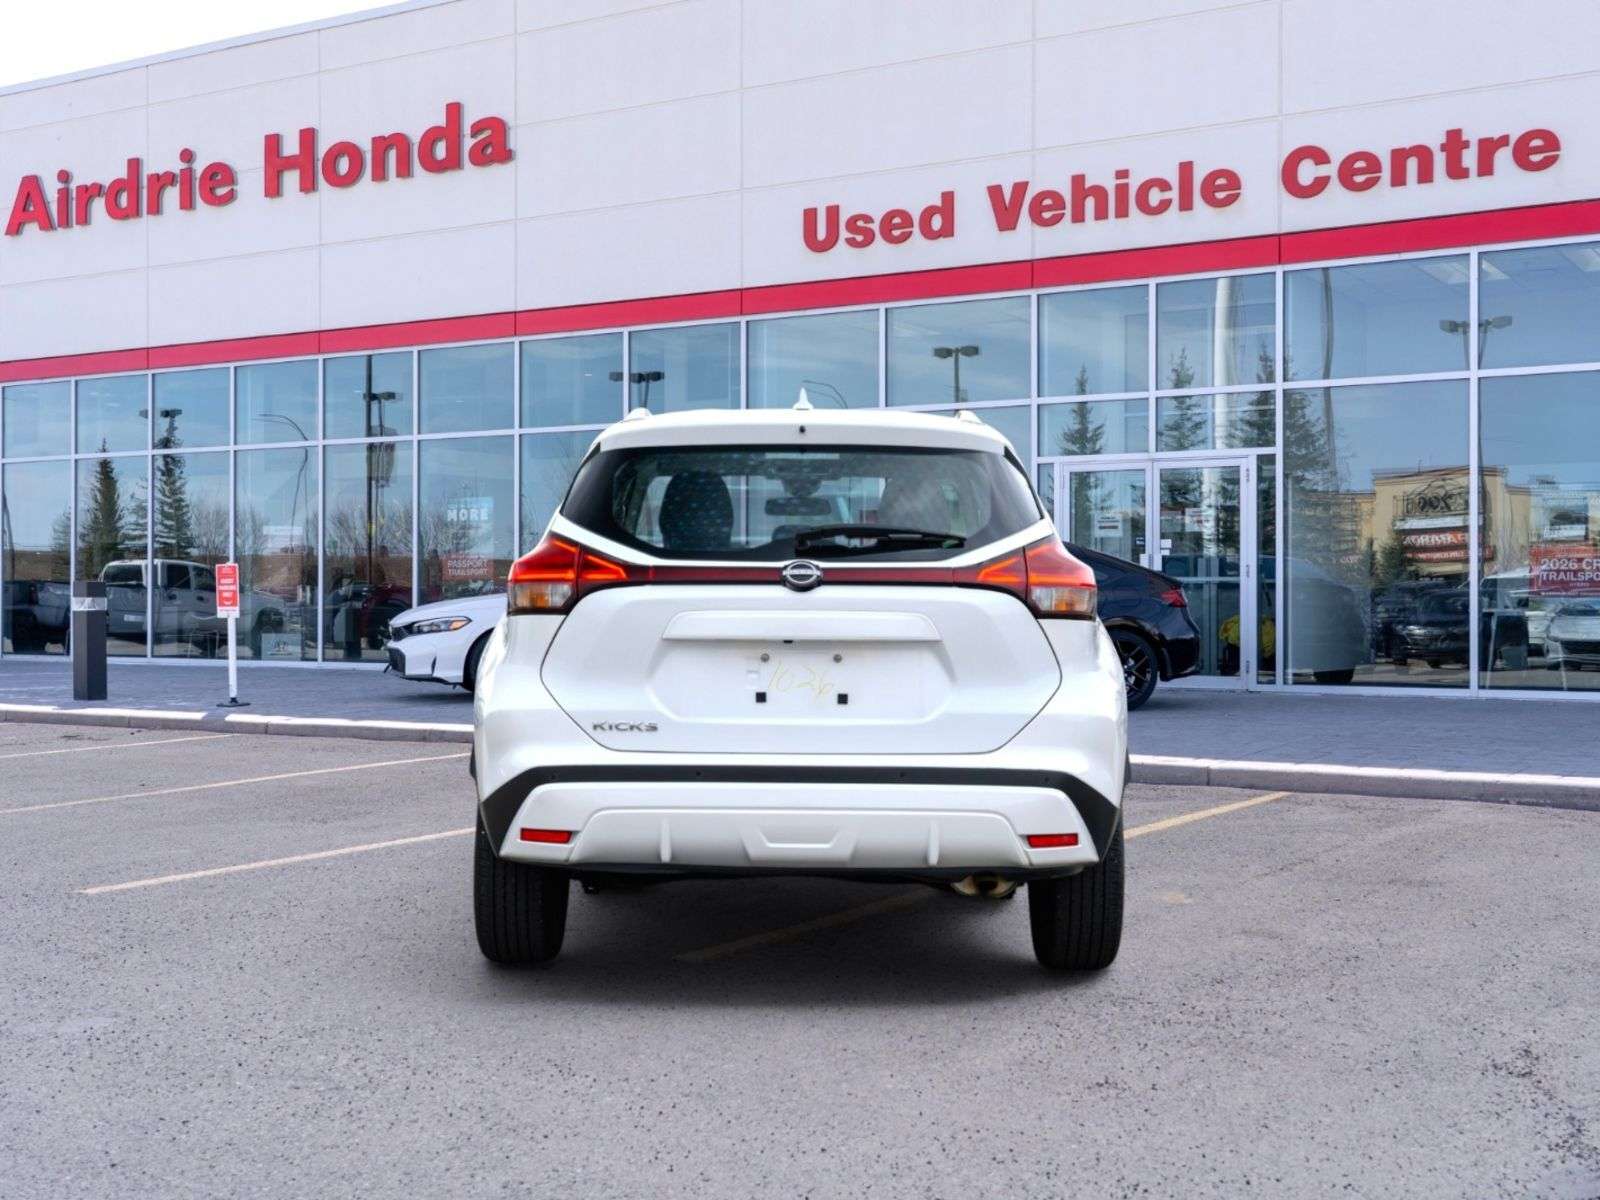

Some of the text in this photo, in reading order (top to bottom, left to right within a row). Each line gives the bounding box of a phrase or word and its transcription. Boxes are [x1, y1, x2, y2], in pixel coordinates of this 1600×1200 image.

[5, 101, 514, 236] Airdrie Honda
[803, 127, 1562, 252] Used Vehicle Centre
[1540, 558, 1578, 571] 2026
